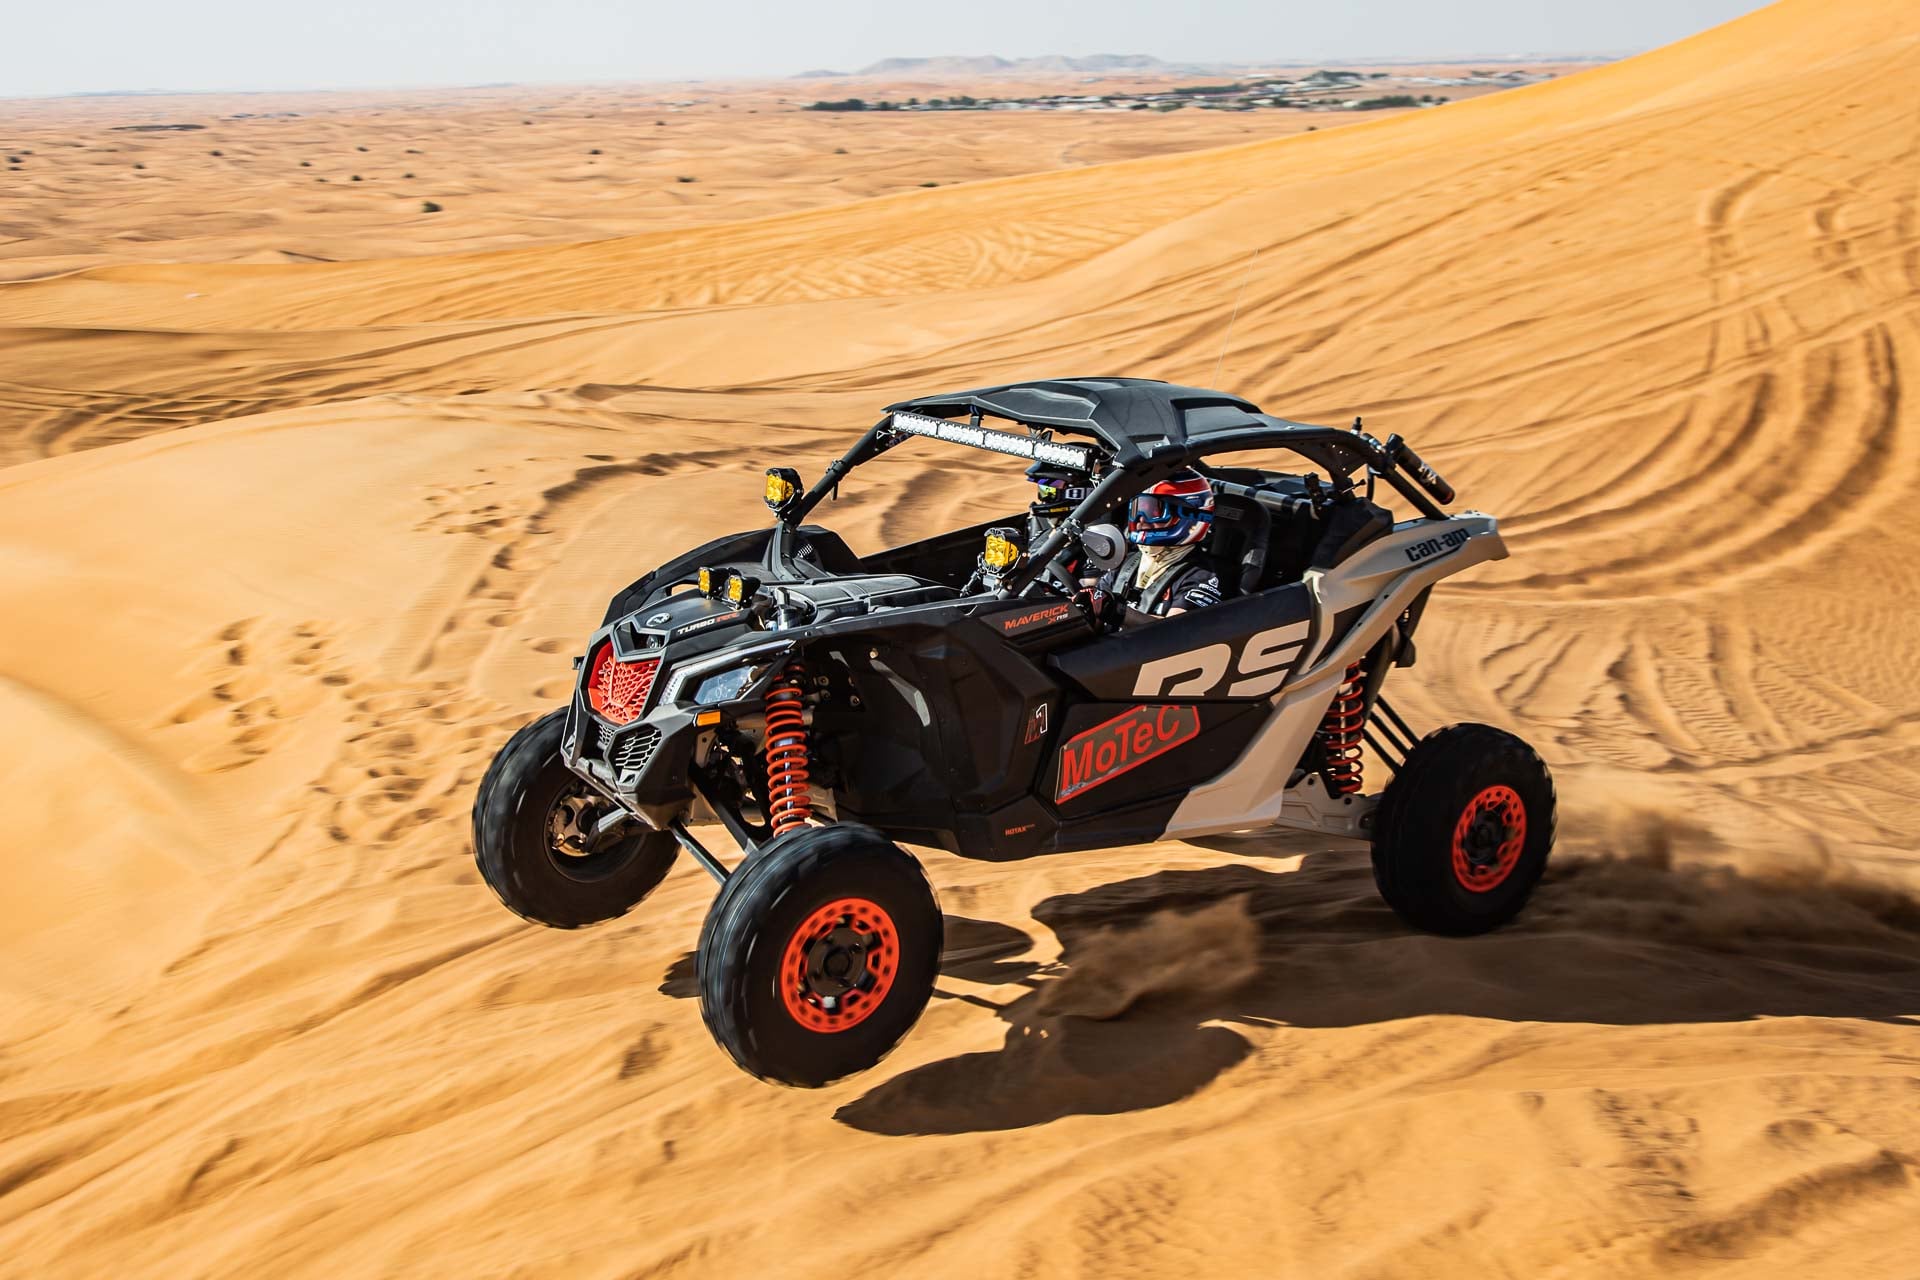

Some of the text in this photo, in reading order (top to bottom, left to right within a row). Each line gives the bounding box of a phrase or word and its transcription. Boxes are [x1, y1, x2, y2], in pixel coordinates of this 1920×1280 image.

[1405, 527, 1471, 562] can-am
[677, 618, 716, 635] TURBO
[1004, 603, 1069, 631] MAVERICK
[1132, 619, 1311, 697] RS
[1061, 705, 1170, 791] MoTeC
